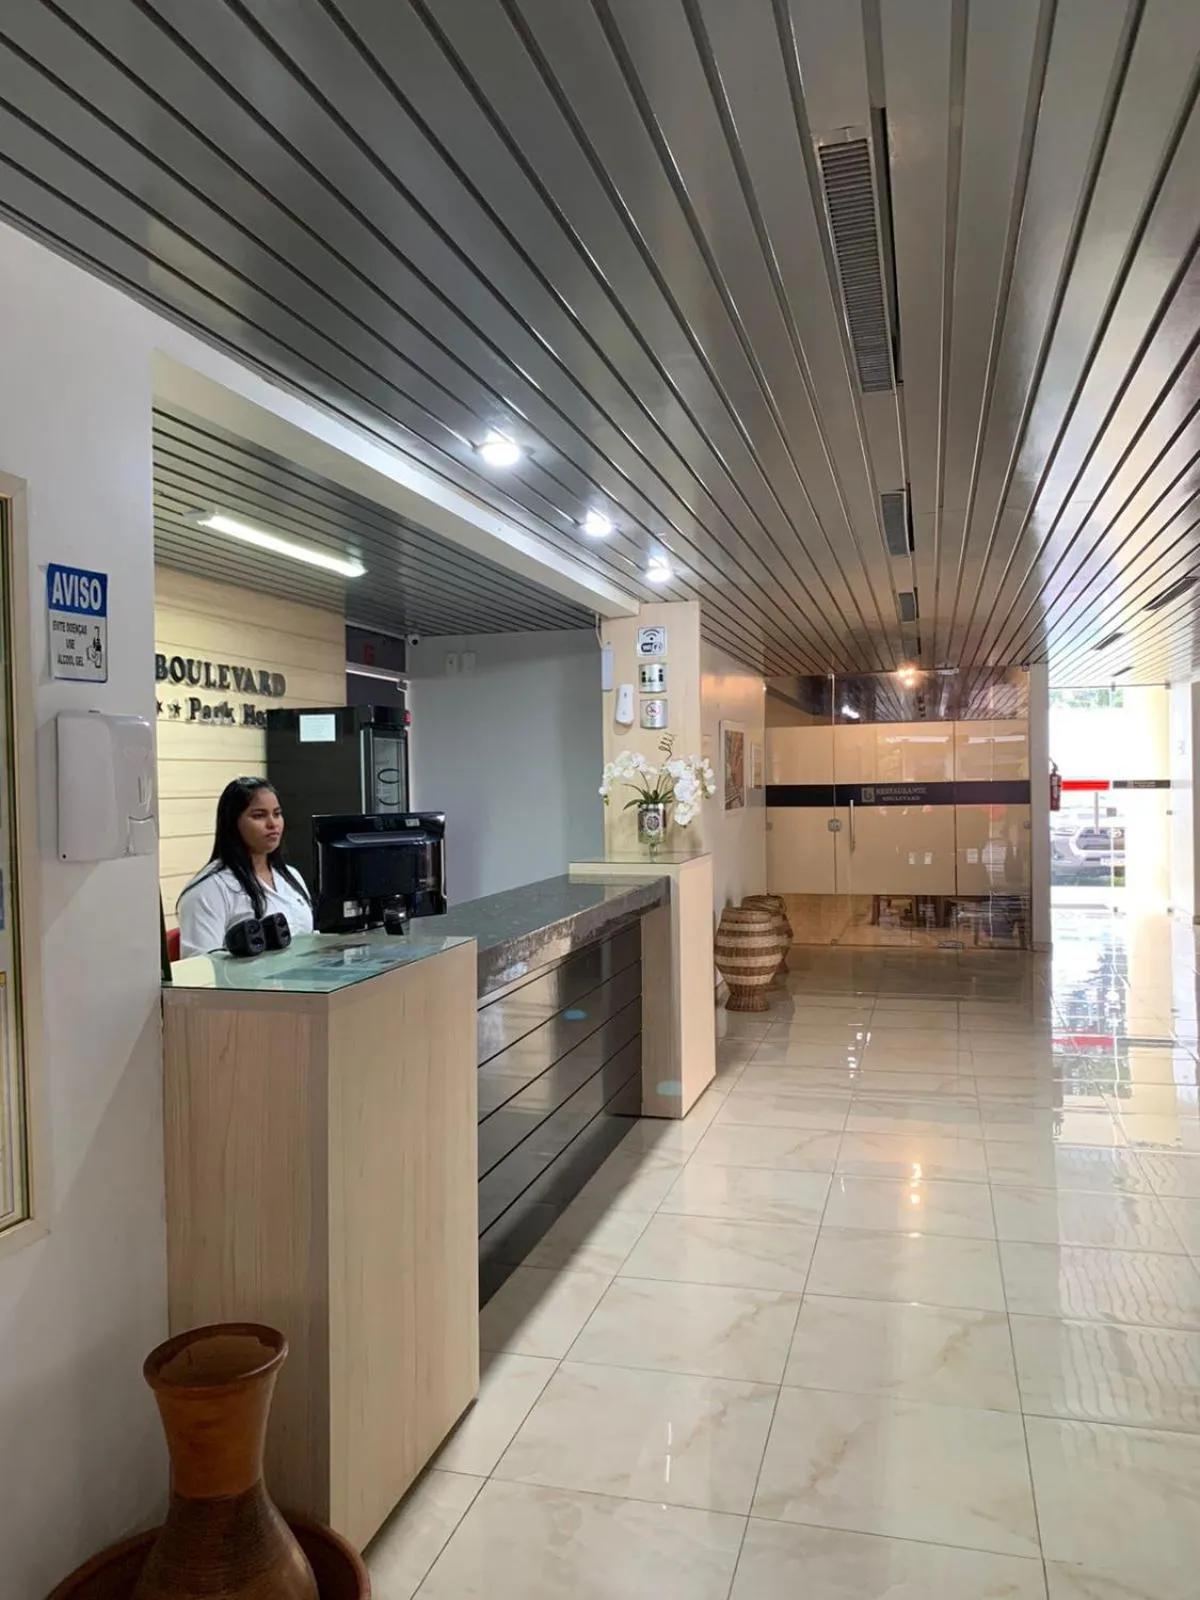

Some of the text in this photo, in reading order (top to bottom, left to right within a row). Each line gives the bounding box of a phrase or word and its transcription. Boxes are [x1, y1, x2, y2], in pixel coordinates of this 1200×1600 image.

[52, 571, 103, 611] AVISO
[155, 654, 286, 698] BOULEVARD
[189, 697, 235, 724] Park
